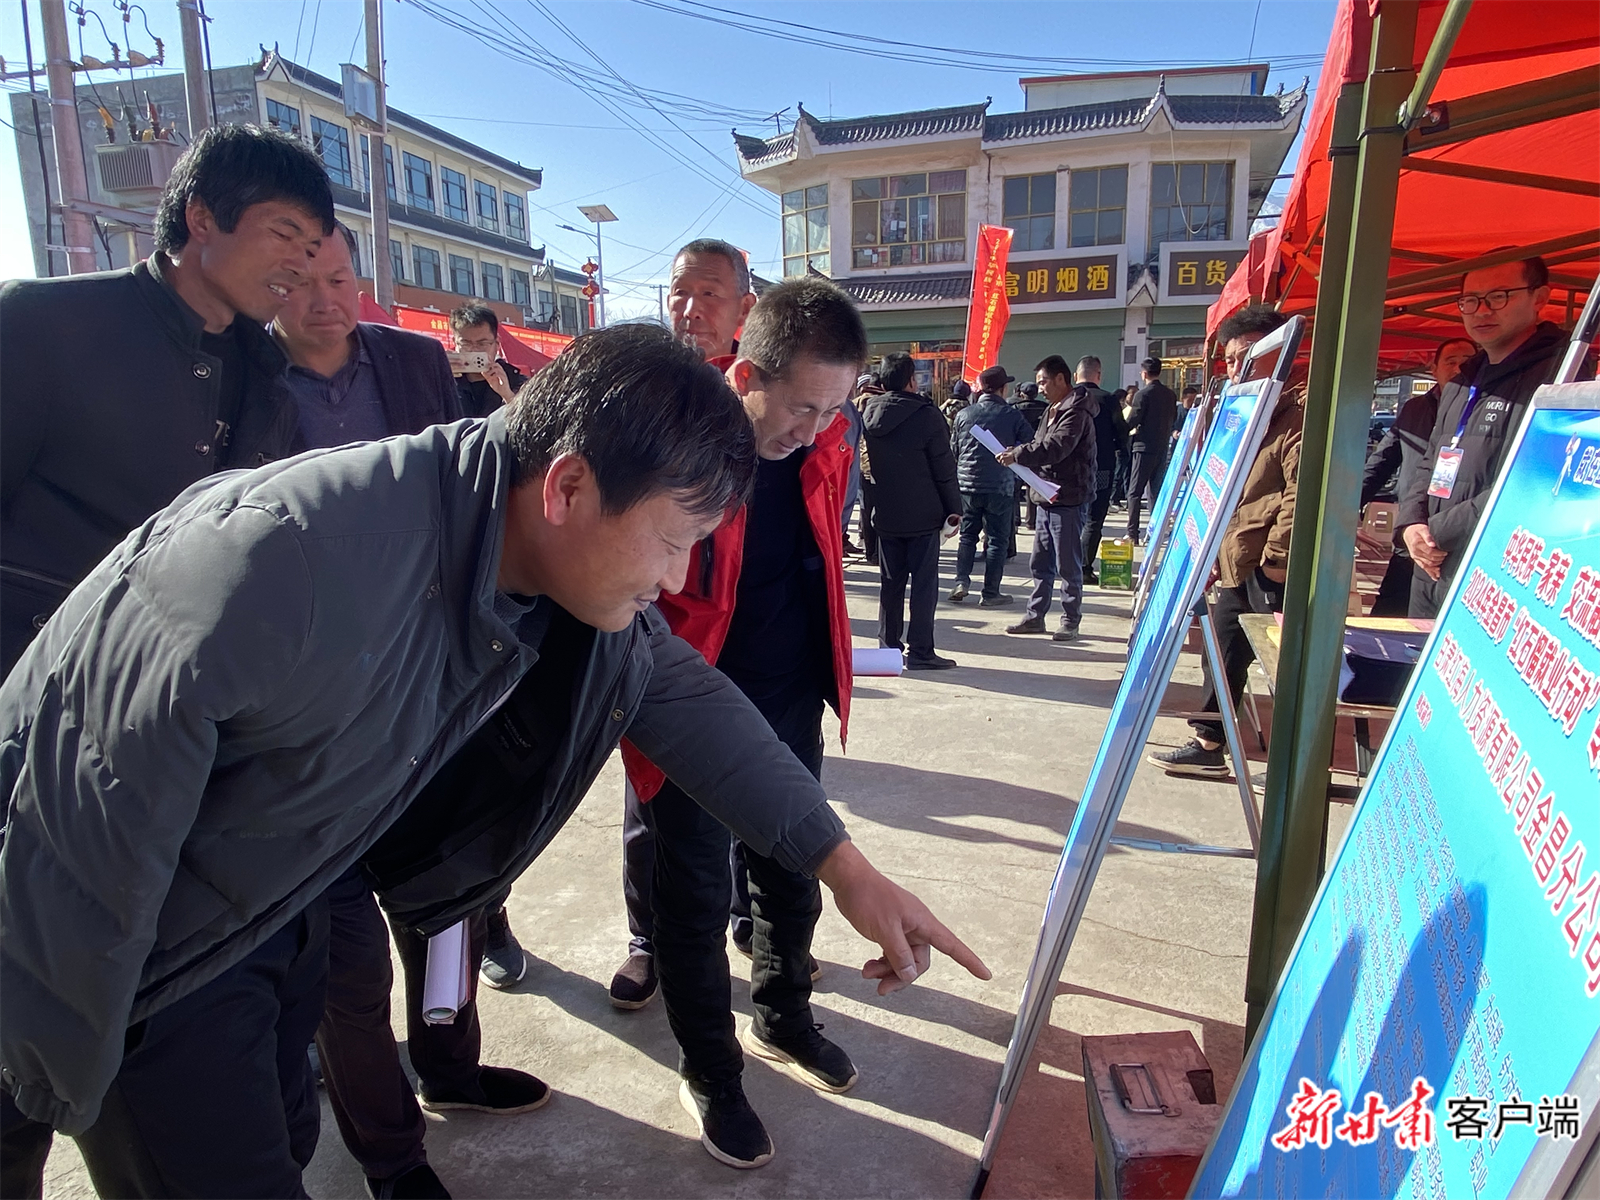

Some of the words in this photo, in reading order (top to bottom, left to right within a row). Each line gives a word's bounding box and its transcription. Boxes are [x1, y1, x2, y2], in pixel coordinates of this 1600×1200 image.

[1005, 264, 1110, 297] 富明烟酒
[1177, 259, 1241, 287] 百货
[1484, 412, 1497, 422] GO
[1502, 528, 1571, 604] 中华民族一家亲
